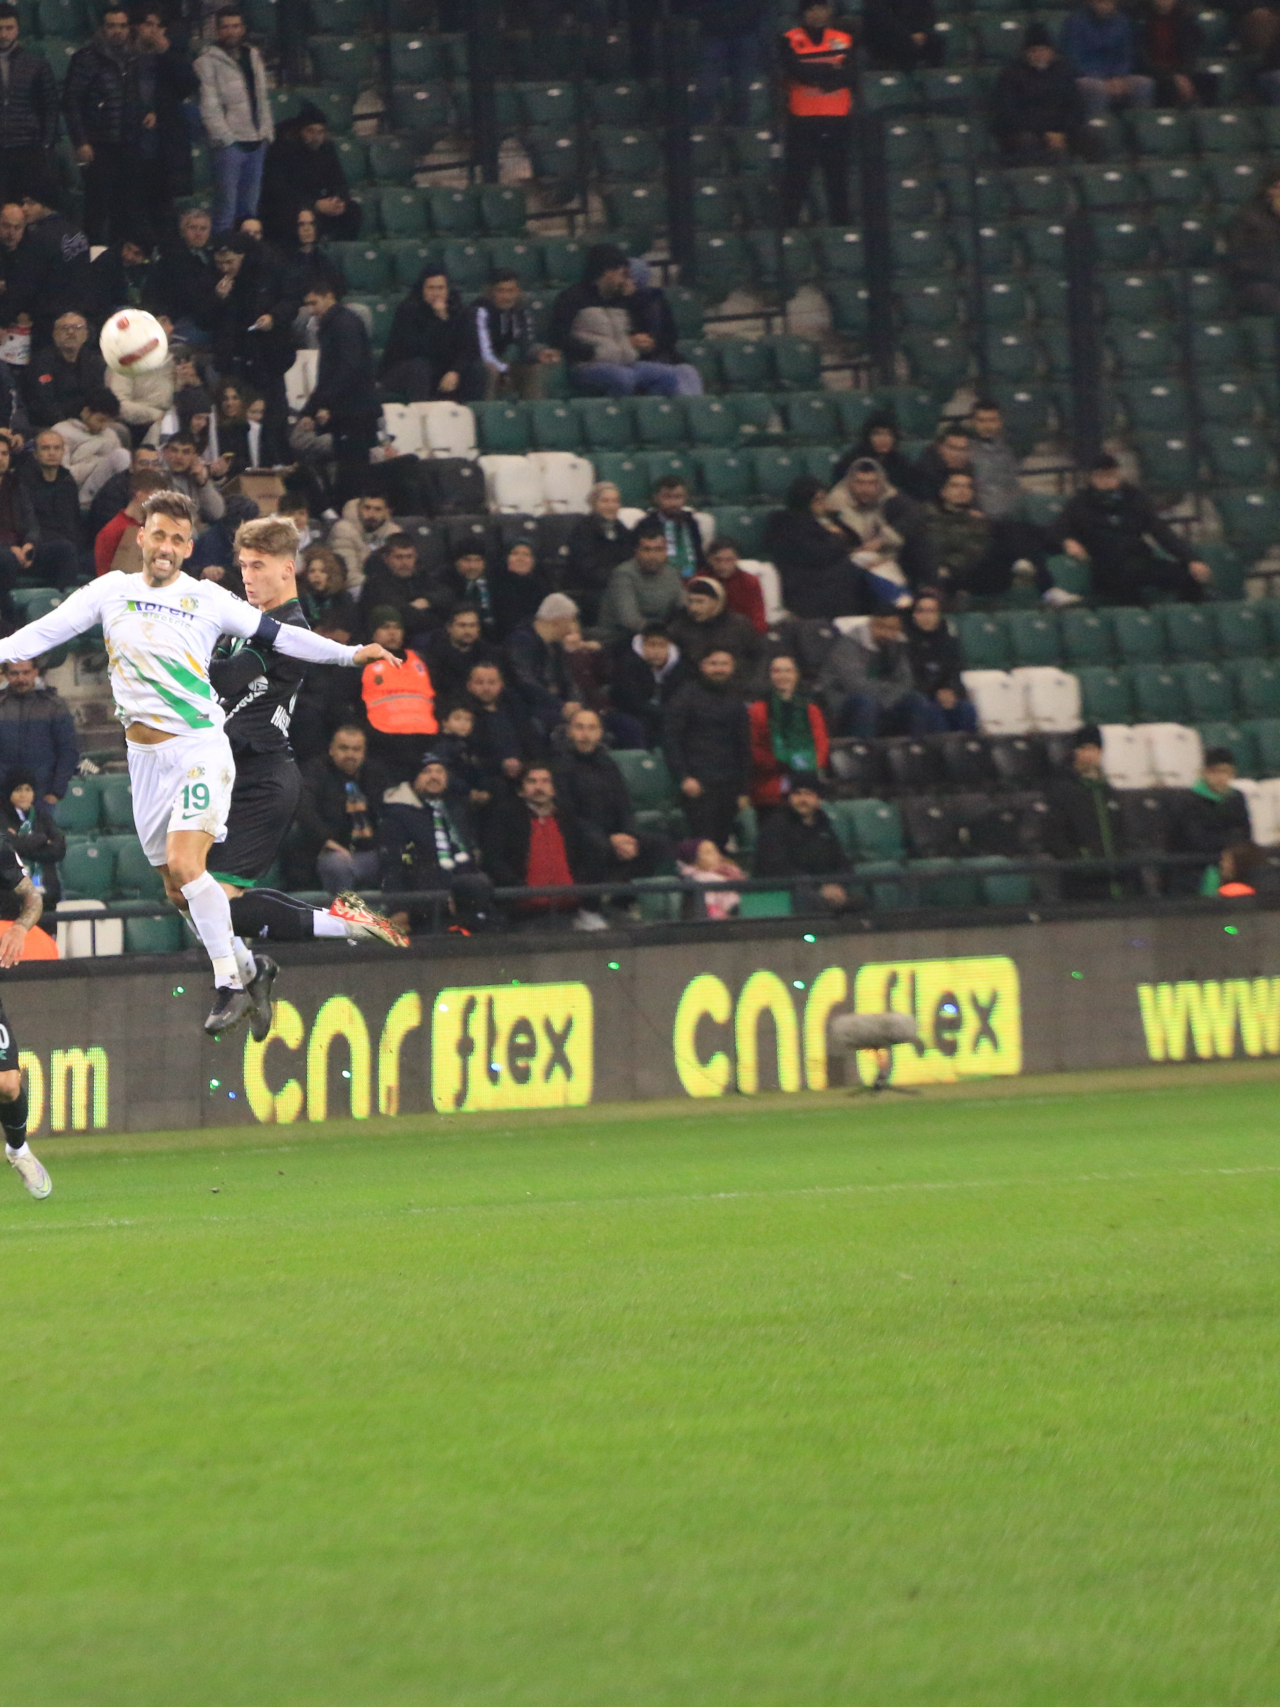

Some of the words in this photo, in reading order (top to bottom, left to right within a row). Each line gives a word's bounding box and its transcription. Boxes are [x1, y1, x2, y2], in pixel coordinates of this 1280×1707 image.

[181, 782, 210, 810] 19
[243, 989, 421, 1124] cnr
[454, 993, 574, 1109] flex
[674, 966, 847, 1098] cnr
